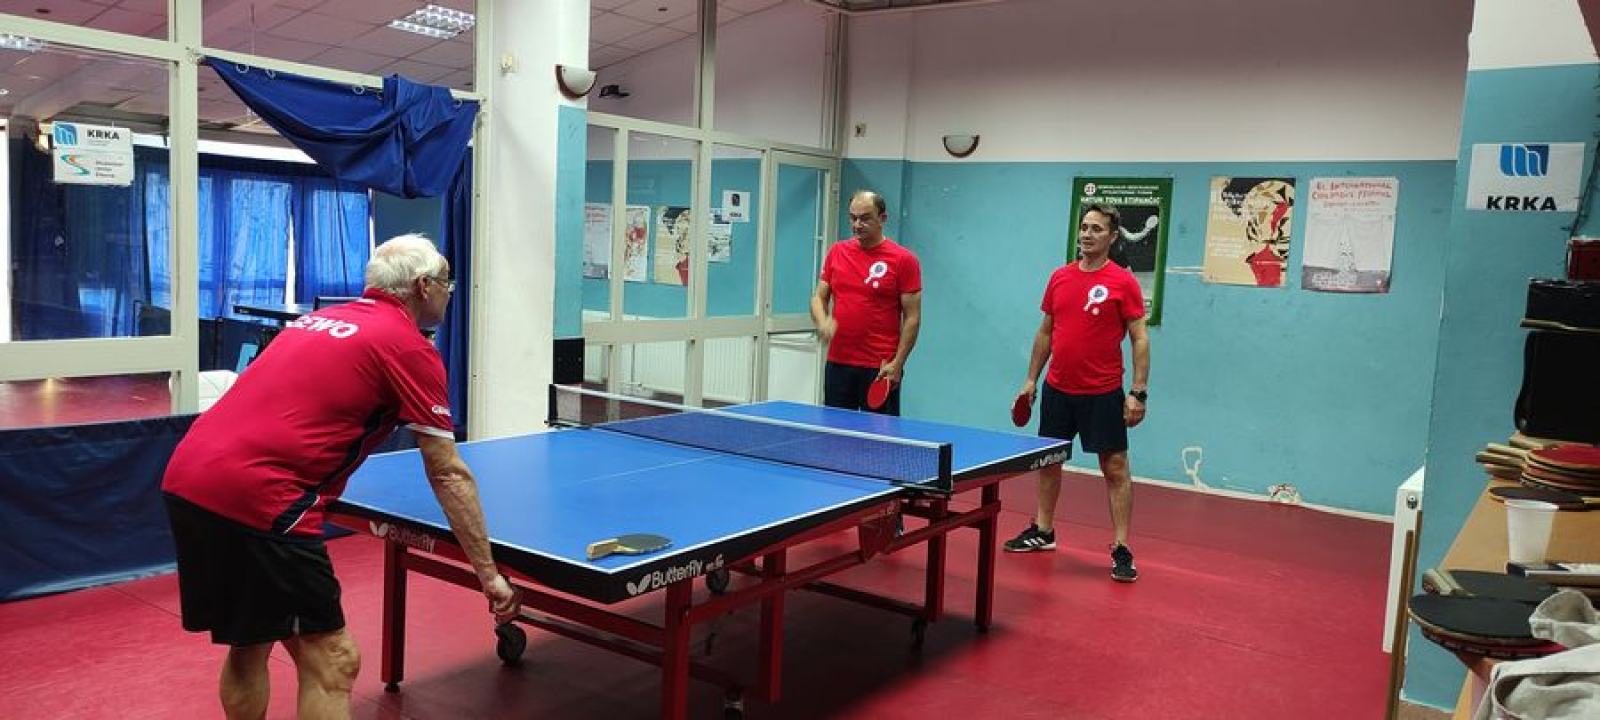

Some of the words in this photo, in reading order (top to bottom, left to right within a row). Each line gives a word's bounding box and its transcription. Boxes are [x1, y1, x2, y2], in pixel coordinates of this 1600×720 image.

[86, 129, 120, 140] KRKA
[1486, 195, 1558, 211] KRKA
[388, 523, 436, 553] Butterfly
[651, 559, 703, 590] Butterfly
